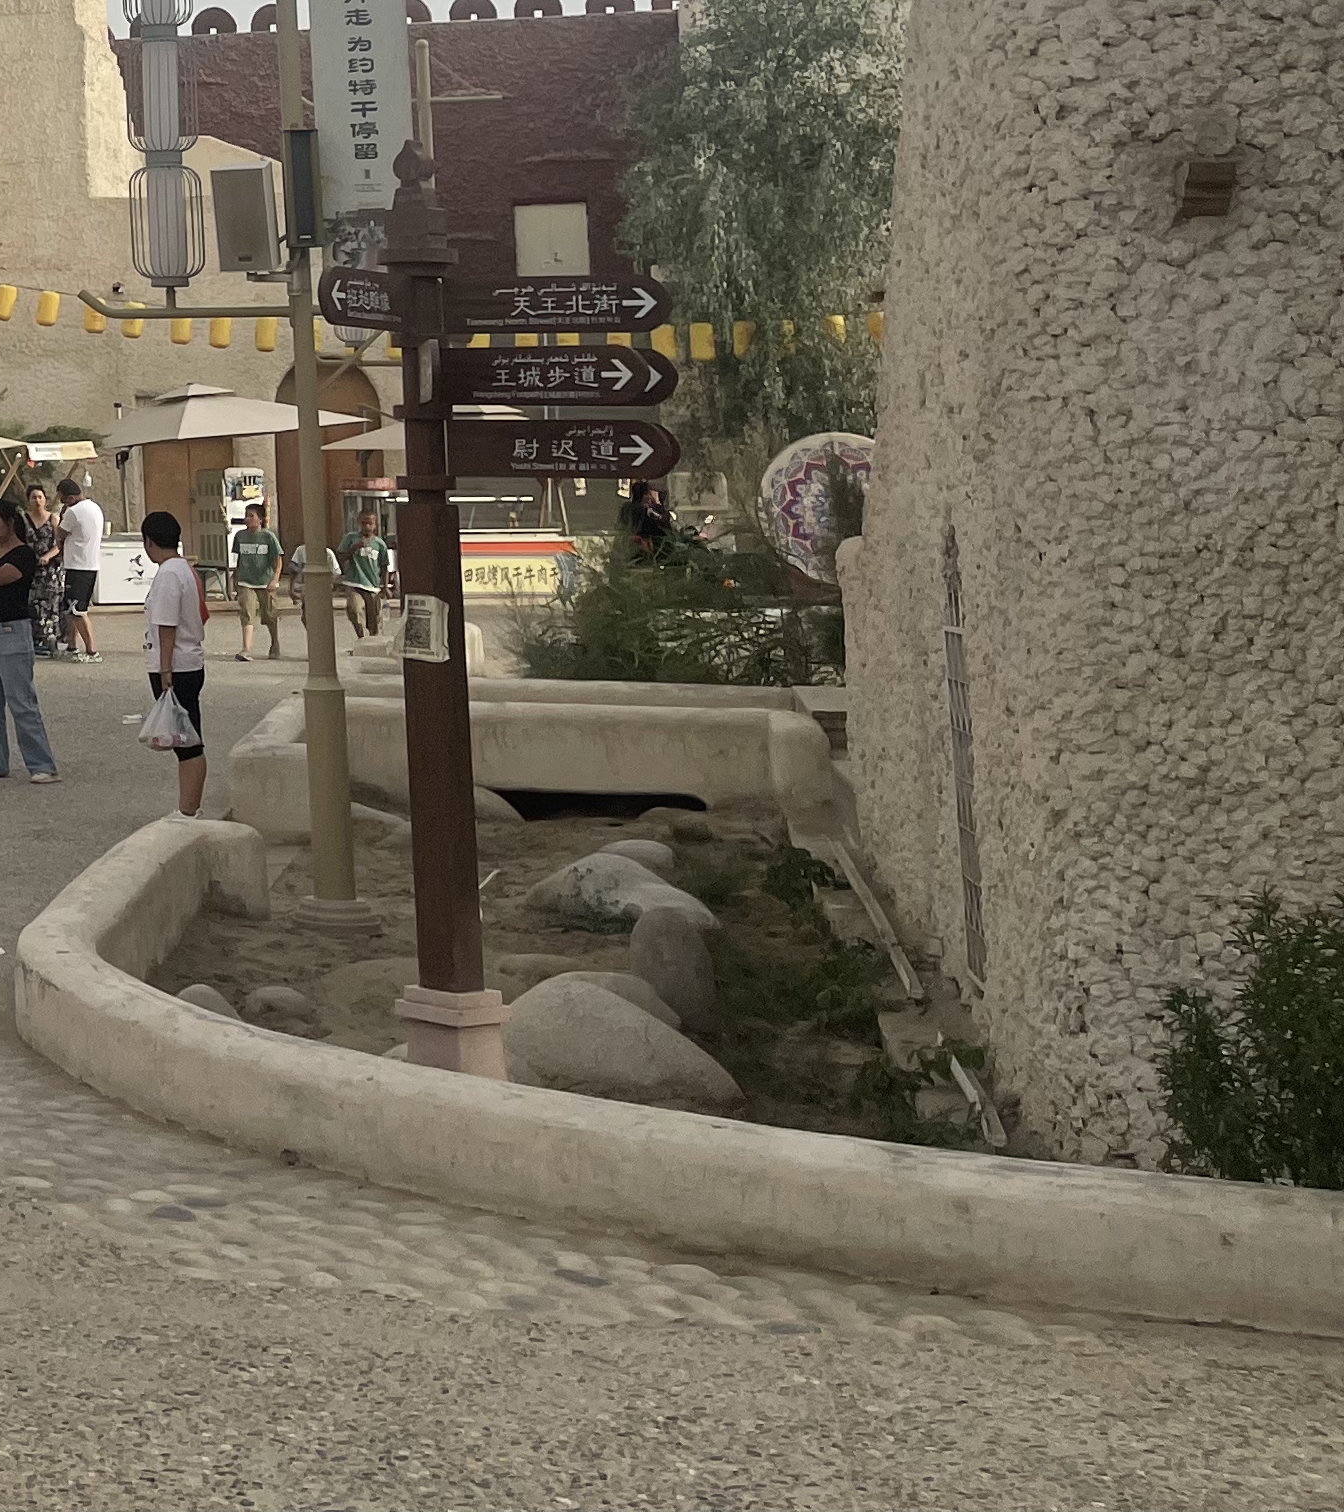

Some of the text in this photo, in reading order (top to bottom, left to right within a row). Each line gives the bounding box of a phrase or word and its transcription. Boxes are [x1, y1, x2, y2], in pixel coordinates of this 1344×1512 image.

[510, 294, 620, 316] 天王北街
[491, 365, 600, 387] 王城步道
[513, 438, 620, 461] 尉迟道
